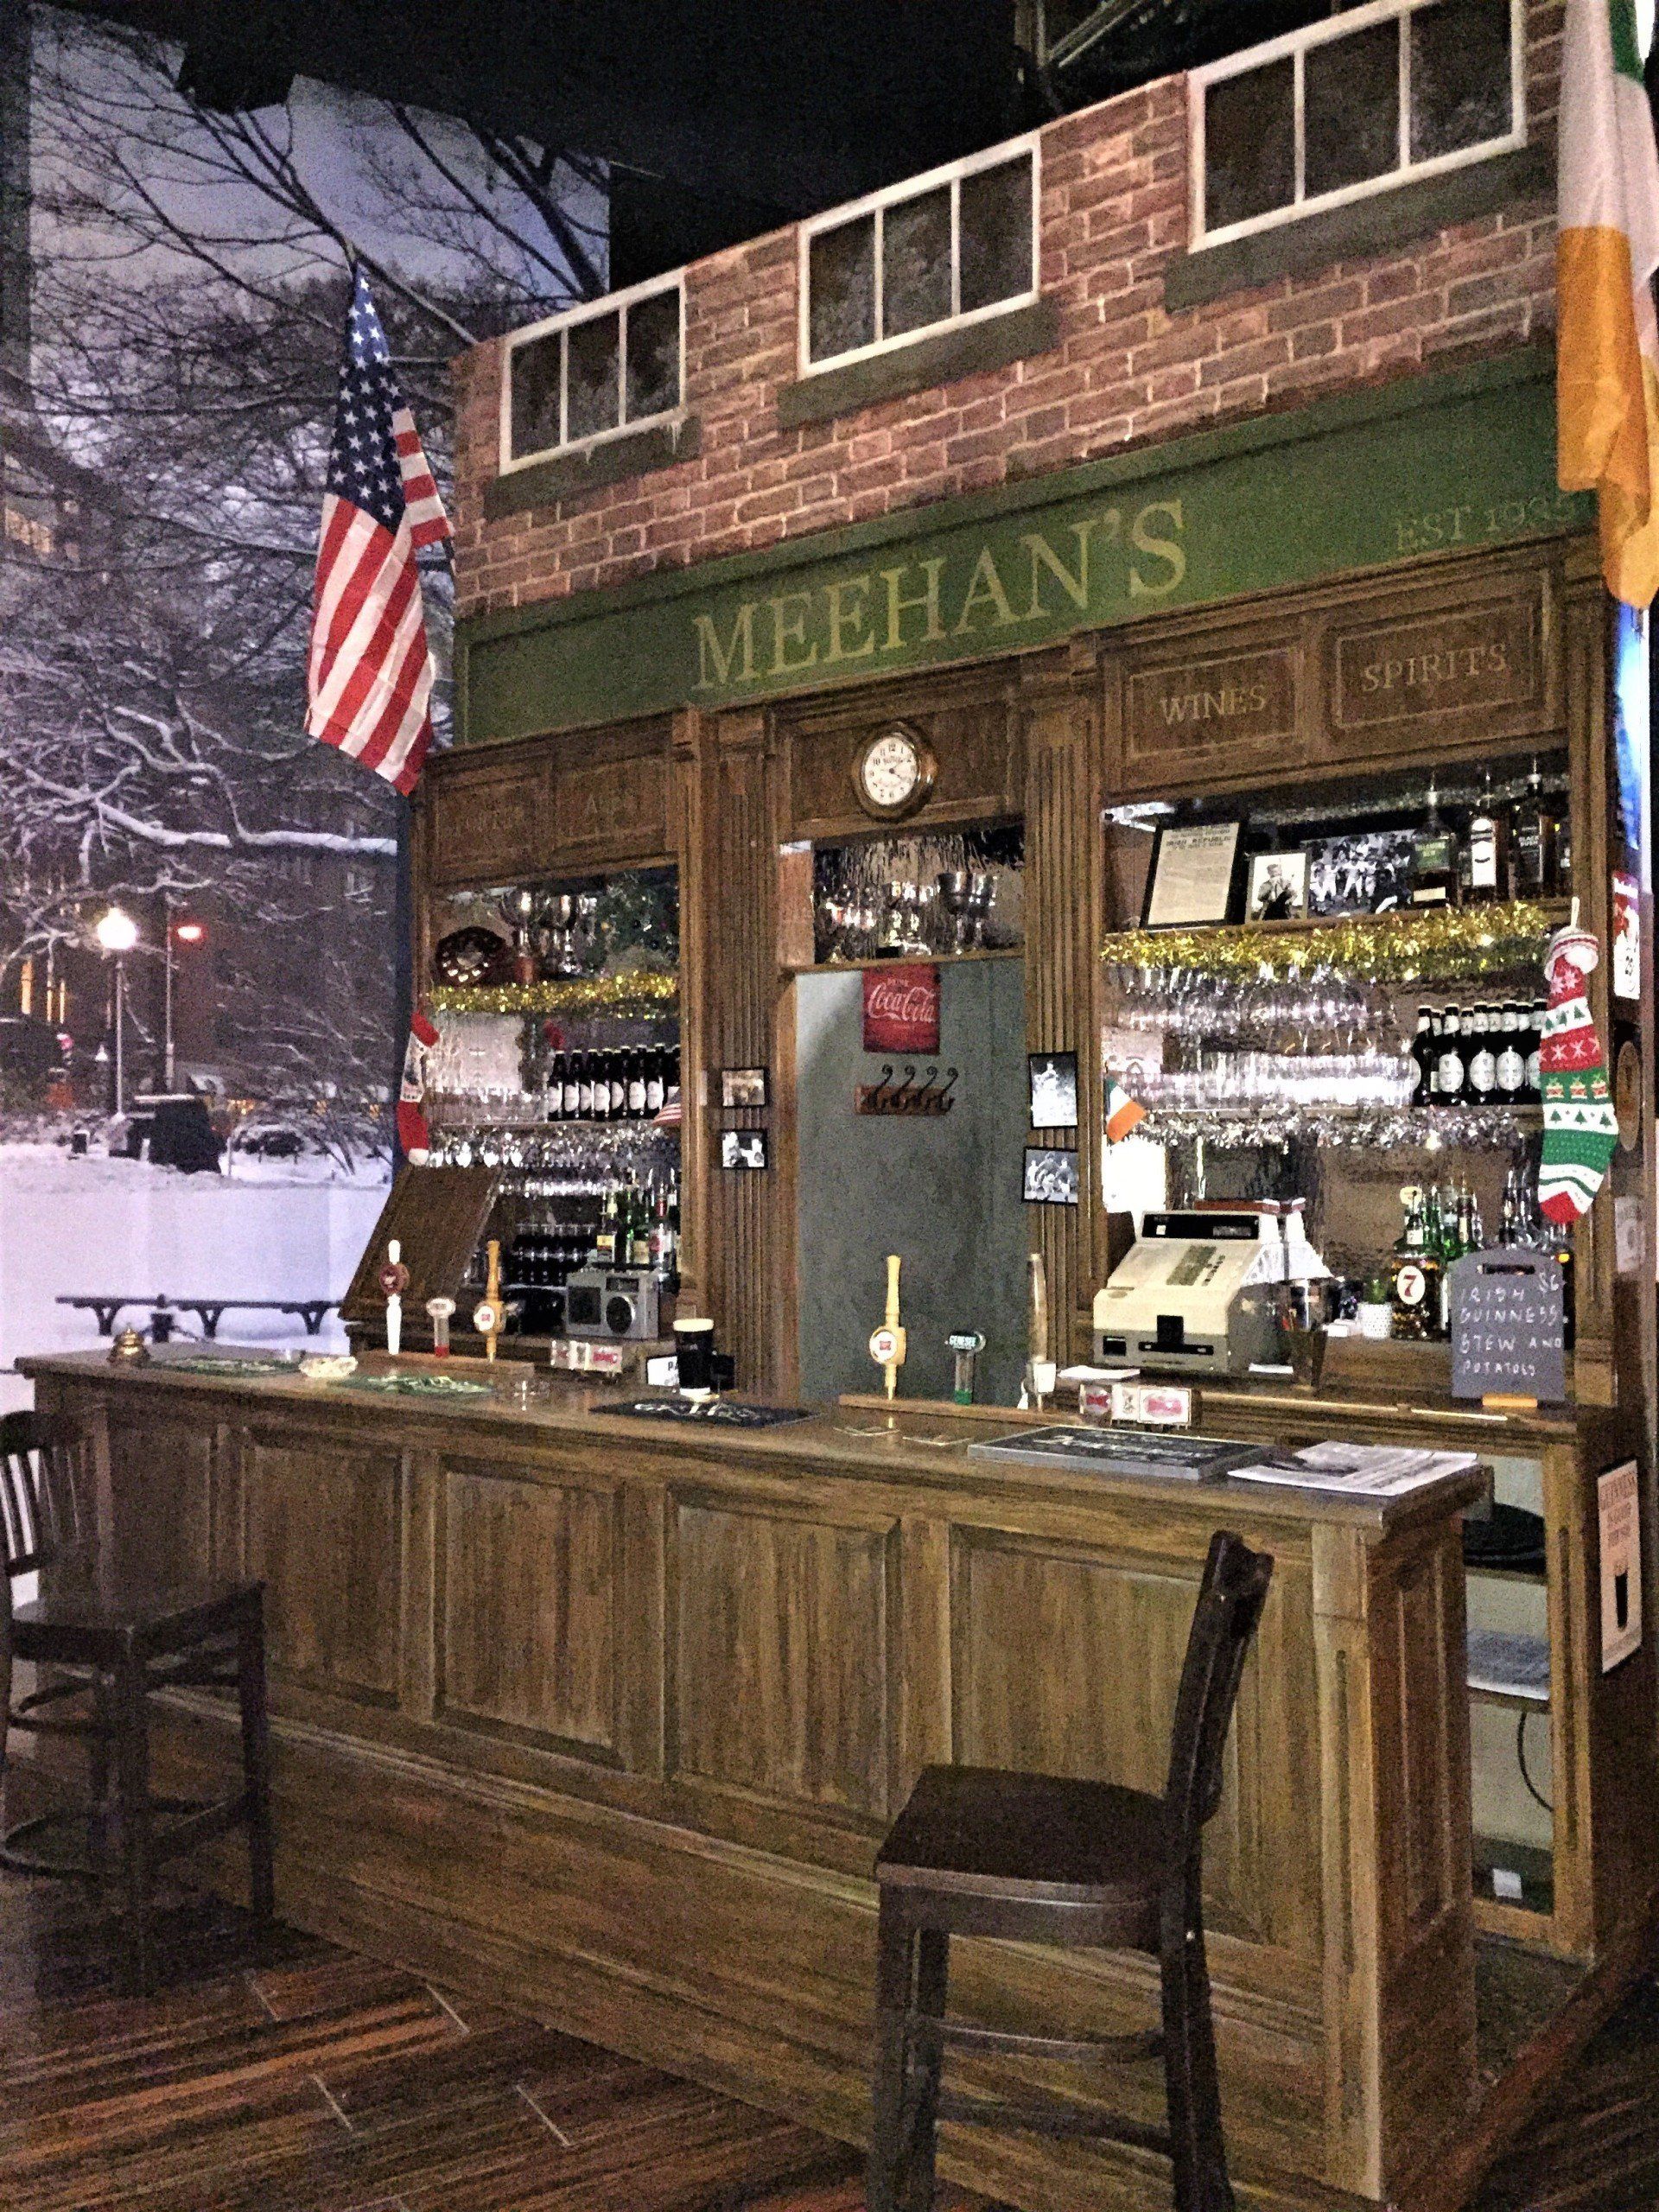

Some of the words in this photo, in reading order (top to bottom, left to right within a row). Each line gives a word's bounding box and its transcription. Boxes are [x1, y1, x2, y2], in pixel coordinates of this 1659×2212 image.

[1395, 504, 1471, 551] EST
[693, 499, 1186, 689] MEEHAN'S
[1363, 643, 1507, 691] SPIRITS
[1160, 685, 1268, 725] WINES
[868, 982, 935, 1022] Coca-Cola
[1404, 1274, 1417, 1297] 7
[1460, 1287, 1524, 1302] IRISH
[1460, 1306, 1556, 1326] GUINNESS
[1460, 1333, 1516, 1353] STEW
[1529, 1338, 1561, 1349] AND
